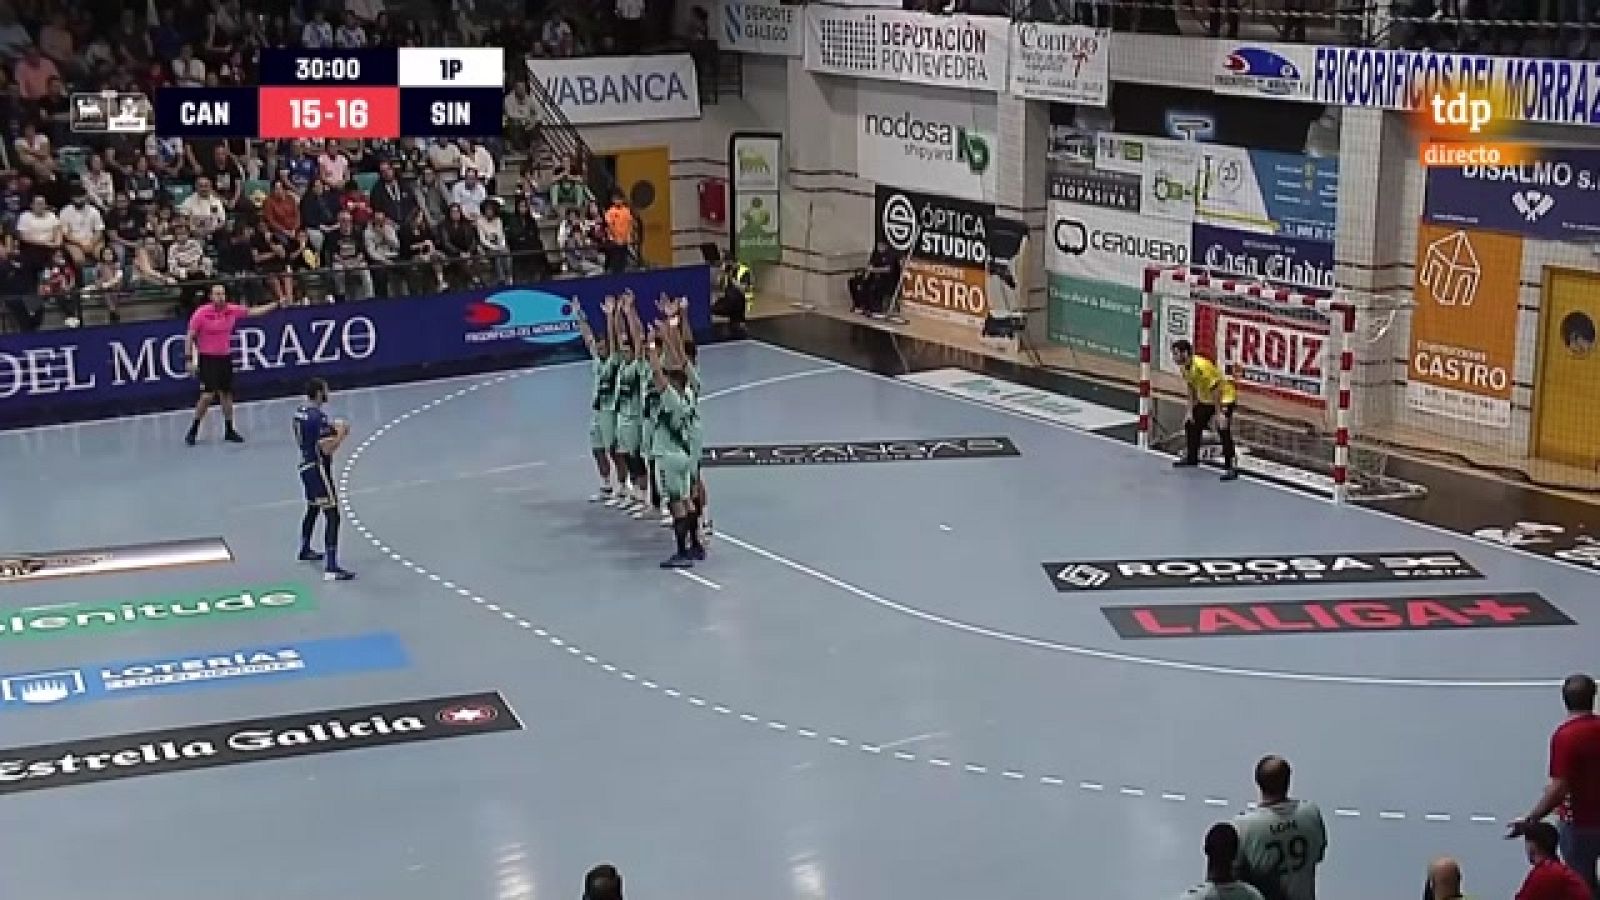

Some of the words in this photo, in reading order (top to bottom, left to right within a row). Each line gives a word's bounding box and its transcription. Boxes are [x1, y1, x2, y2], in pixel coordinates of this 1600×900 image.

[881, 20, 986, 54] DEPUTACIÓN
[881, 49, 988, 81] PONTEVEDRA
[865, 112, 951, 145] nodosa
[920, 202, 986, 238] ÓPTICA
[921, 231, 986, 261] STUDIO
[902, 270, 984, 313] CASTRO
[108, 316, 376, 386] MORAZO
[1226, 320, 1323, 377] FROIZ
[1414, 351, 1506, 390] CASTRO
[1117, 555, 1374, 576] RODOSA
[0, 592, 297, 633] lenitude
[1134, 598, 1533, 635] LALIGA+
[0, 739, 217, 781] Estrella
[226, 712, 426, 751] Galicia
